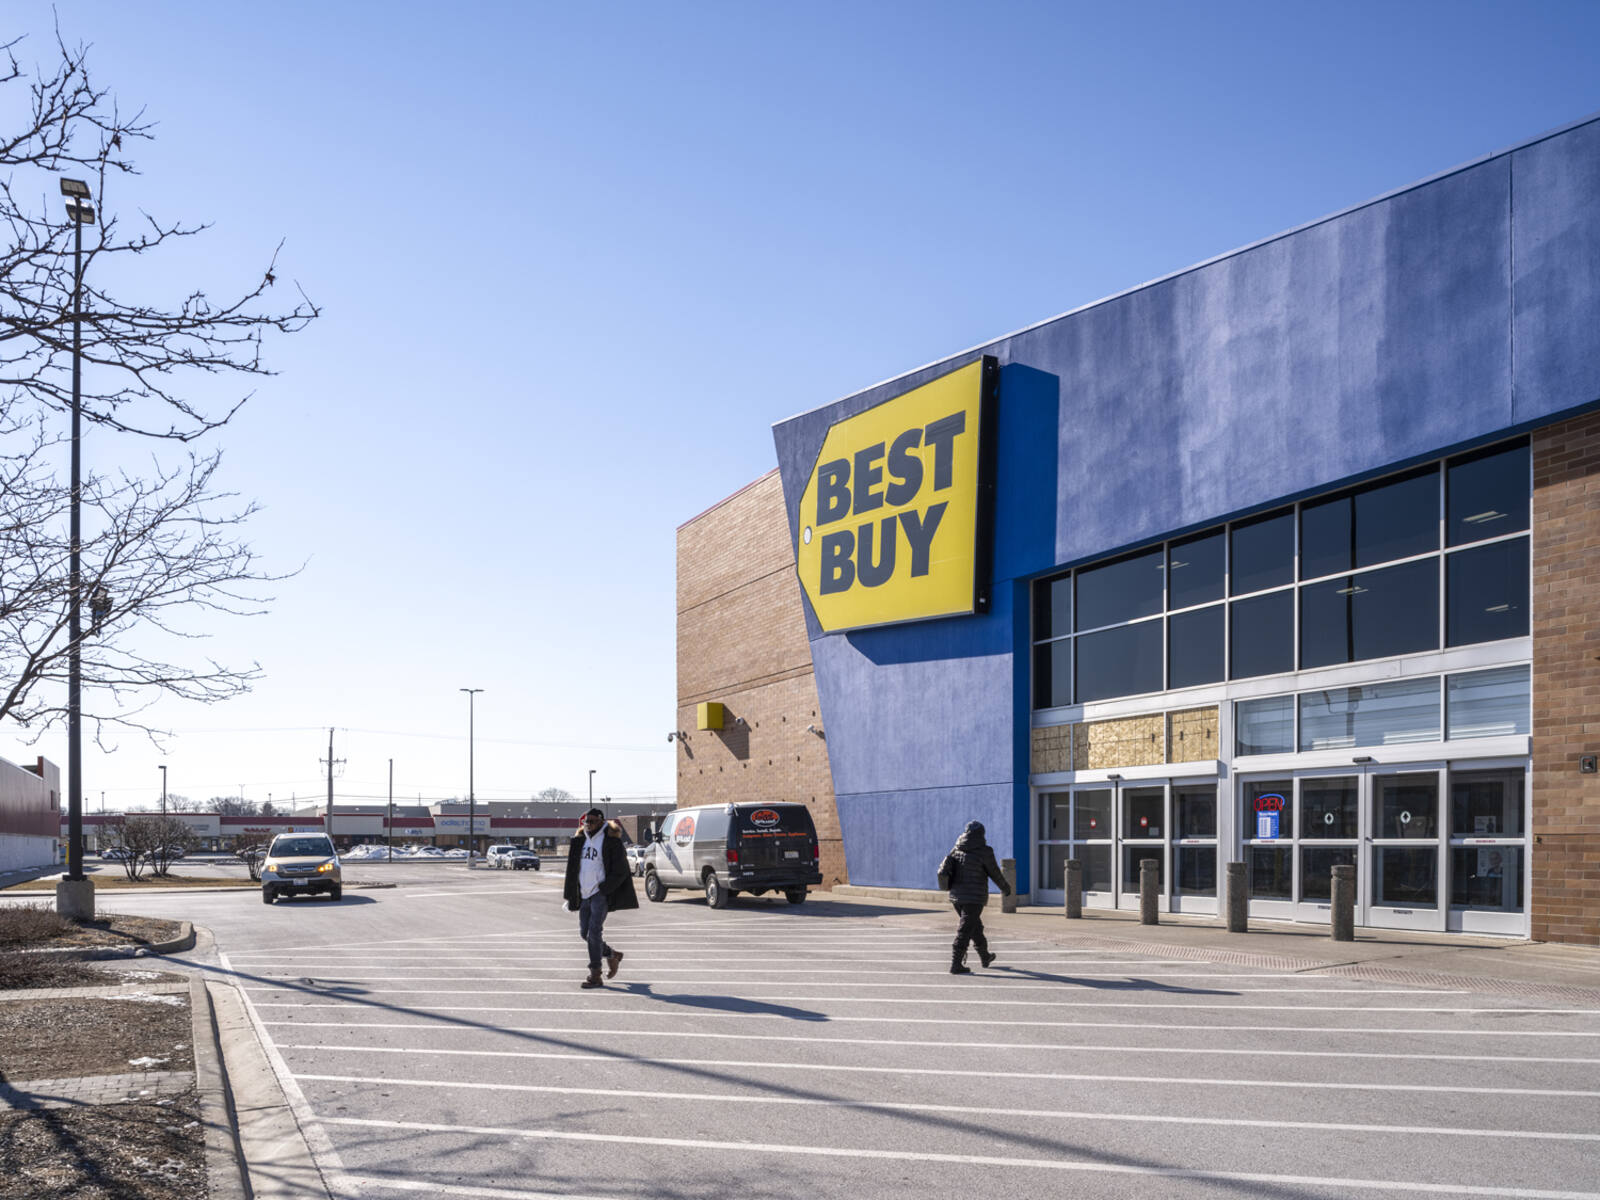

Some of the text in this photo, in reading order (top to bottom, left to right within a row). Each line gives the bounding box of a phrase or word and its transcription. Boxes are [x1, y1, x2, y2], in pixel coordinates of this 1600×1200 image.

[816, 410, 966, 527] BEST
[820, 501, 949, 596] BUY
[1254, 798, 1283, 811] OPEN
